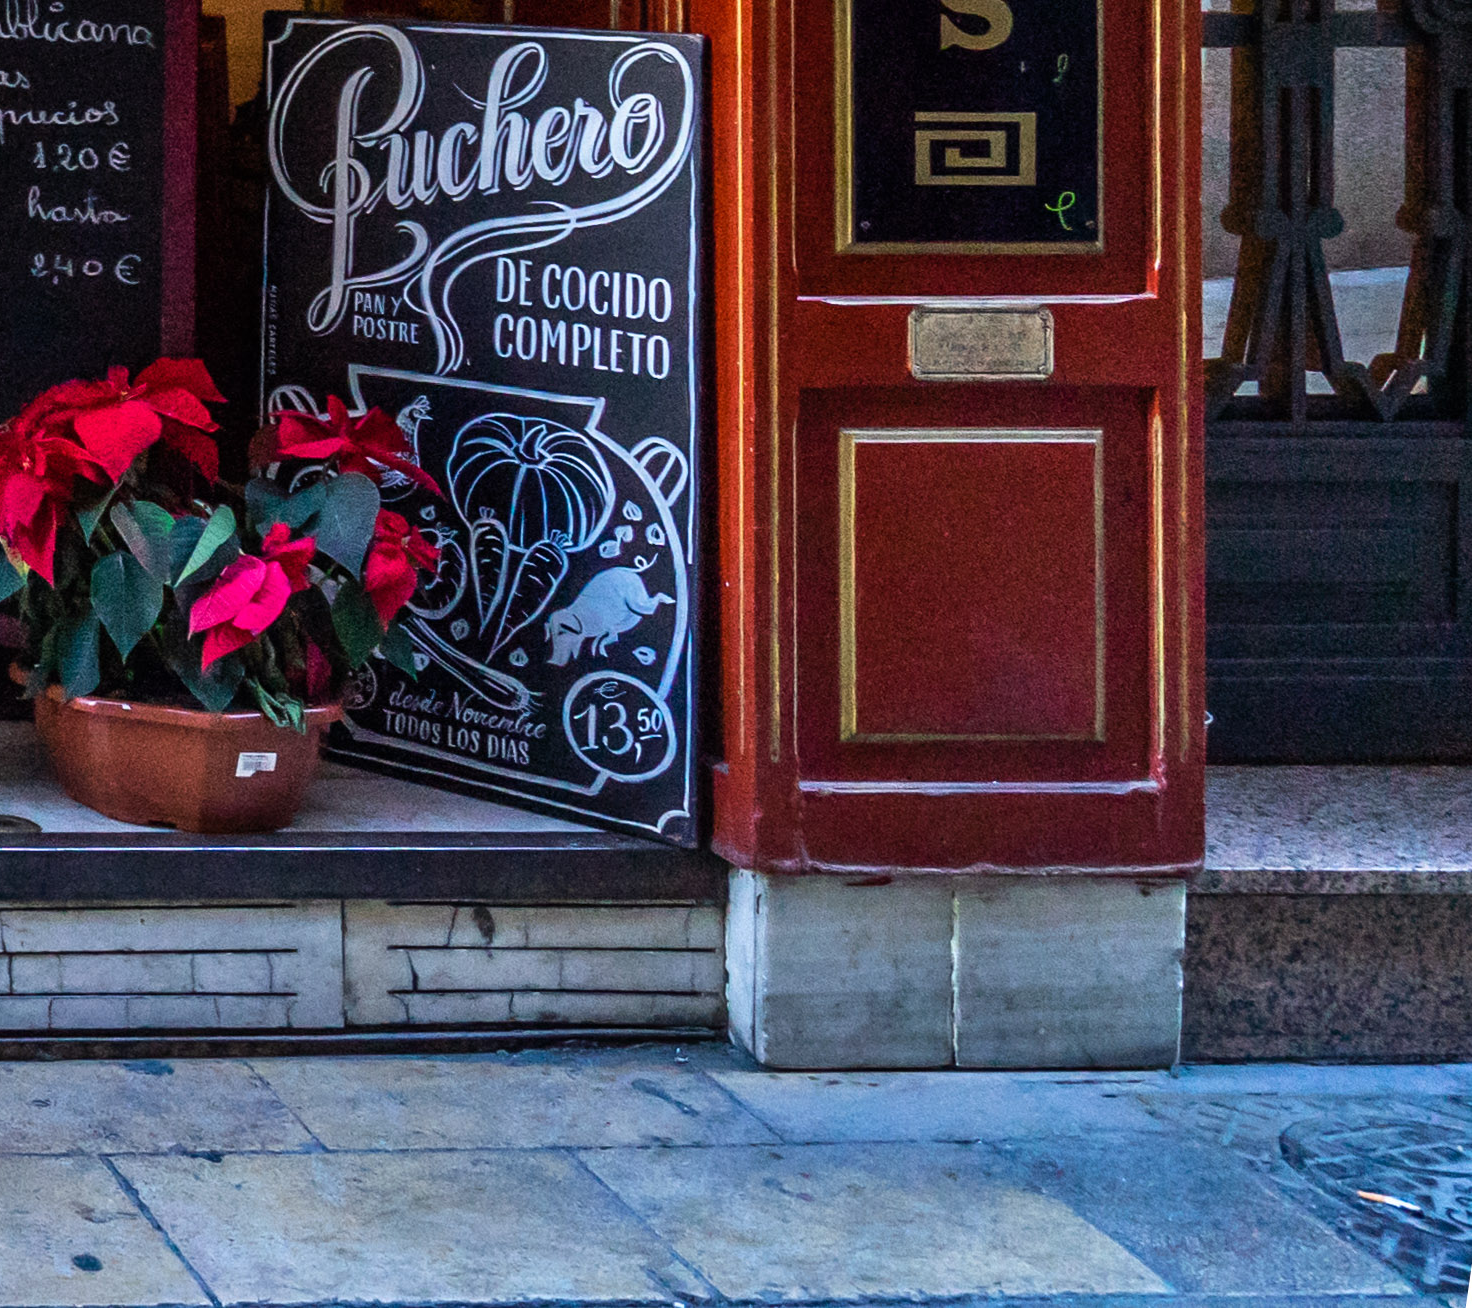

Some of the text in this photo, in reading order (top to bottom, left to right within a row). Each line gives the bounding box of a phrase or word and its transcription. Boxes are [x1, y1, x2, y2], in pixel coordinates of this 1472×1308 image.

[106, 140, 133, 173] €
[267, 23, 694, 336] Puchero
[26, 184, 133, 226] hasta
[113, 252, 144, 286] €
[353, 290, 404, 317] PAN Y
[495, 256, 673, 325] DE COCIDO
[352, 314, 420, 345] POSTRE
[493, 312, 671, 381] COMPLETO
[389, 682, 445, 717] desde
[383, 708, 442, 745] TODOS
[447, 725, 481, 754] LOS
